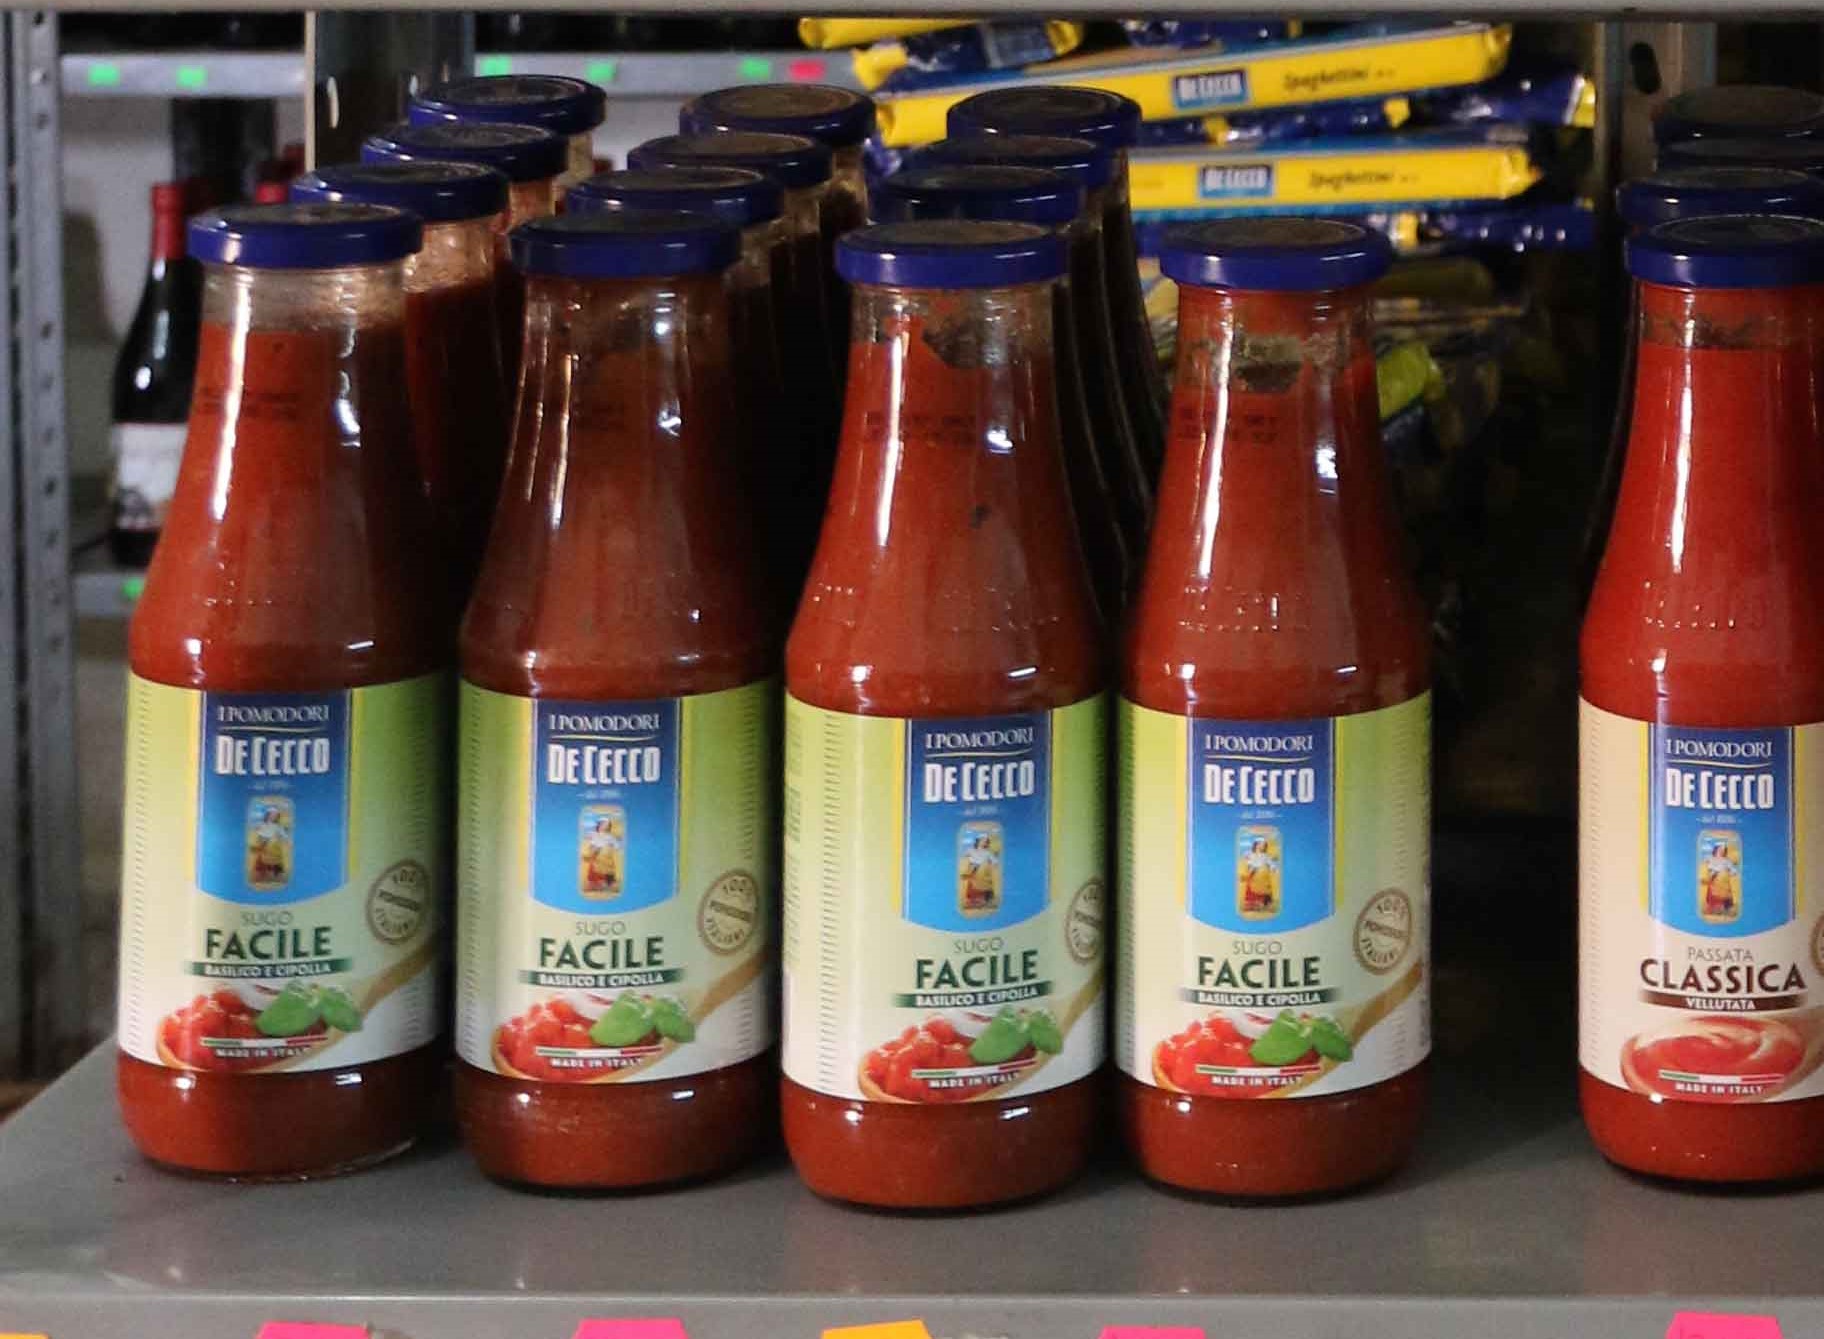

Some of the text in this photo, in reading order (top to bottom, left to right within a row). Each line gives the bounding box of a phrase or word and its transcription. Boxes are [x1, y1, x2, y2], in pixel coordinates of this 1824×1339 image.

[225, 705, 329, 724] POMODORI
[556, 713, 659, 732] POMODORI
[933, 727, 1034, 751] POMODORI
[1213, 734, 1313, 753] POMODORI
[1676, 740, 1773, 759] POMODORI
[216, 736, 329, 775] DE CECCO
[547, 744, 660, 785] DE CECCO
[924, 761, 1034, 804] DE CECCO
[1204, 763, 1315, 804] DE CECCO
[1666, 768, 1774, 810] DE CECCO
[242, 912, 292, 927] SUGO
[576, 920, 625, 936] SUGO
[206, 927, 331, 960] FACILE
[539, 937, 664, 969] FACILE
[954, 938, 1004, 955] SUGO
[1232, 941, 1282, 956] SUGO
[1687, 947, 1755, 963] PASSATA
[539, 972, 664, 986] BASILICO CIPOLLA
[916, 950, 1038, 990] FACILE
[1199, 956, 1321, 989] FACILE
[1639, 957, 1807, 994] CLASSICA
[1686, 996, 1756, 1011] VELLUTATA
